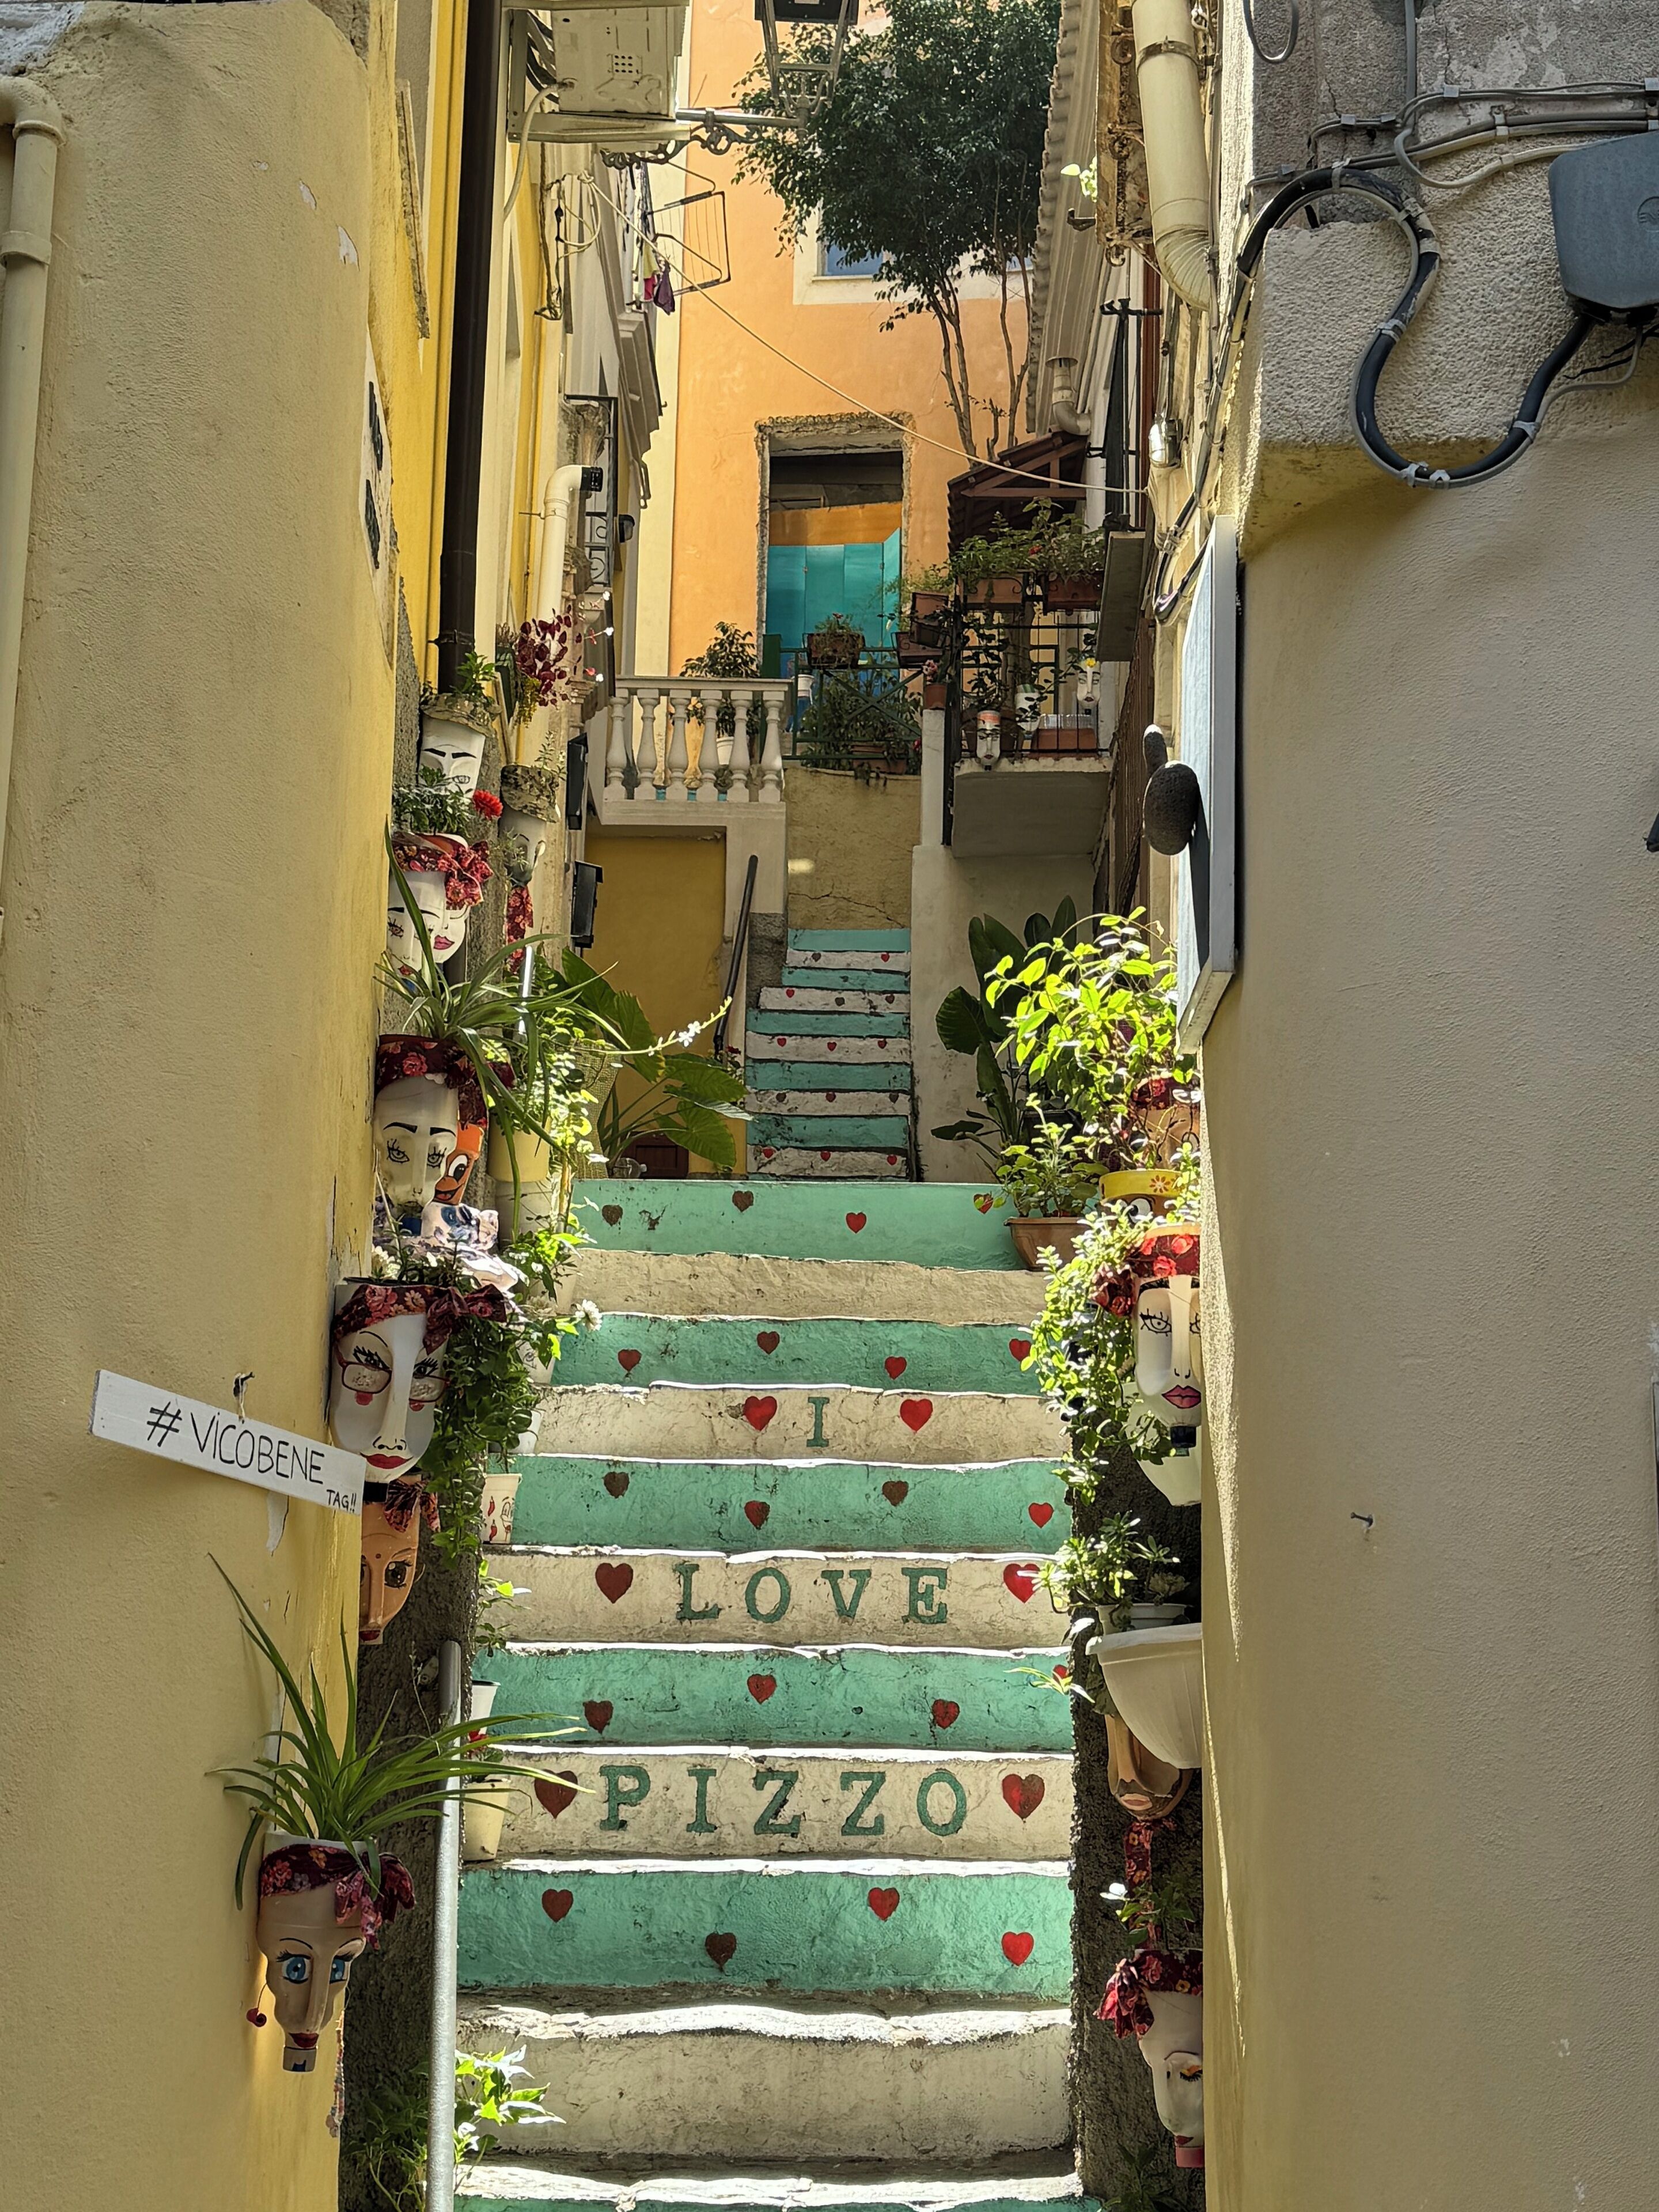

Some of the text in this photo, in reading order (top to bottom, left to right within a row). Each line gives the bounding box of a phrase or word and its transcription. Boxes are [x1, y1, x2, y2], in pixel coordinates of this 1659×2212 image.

[806, 1397, 830, 1448] I
[326, 1489, 357, 1512] TAG!!
[673, 1563, 948, 1624] LOVE
[599, 1765, 968, 1837] PIZZO
